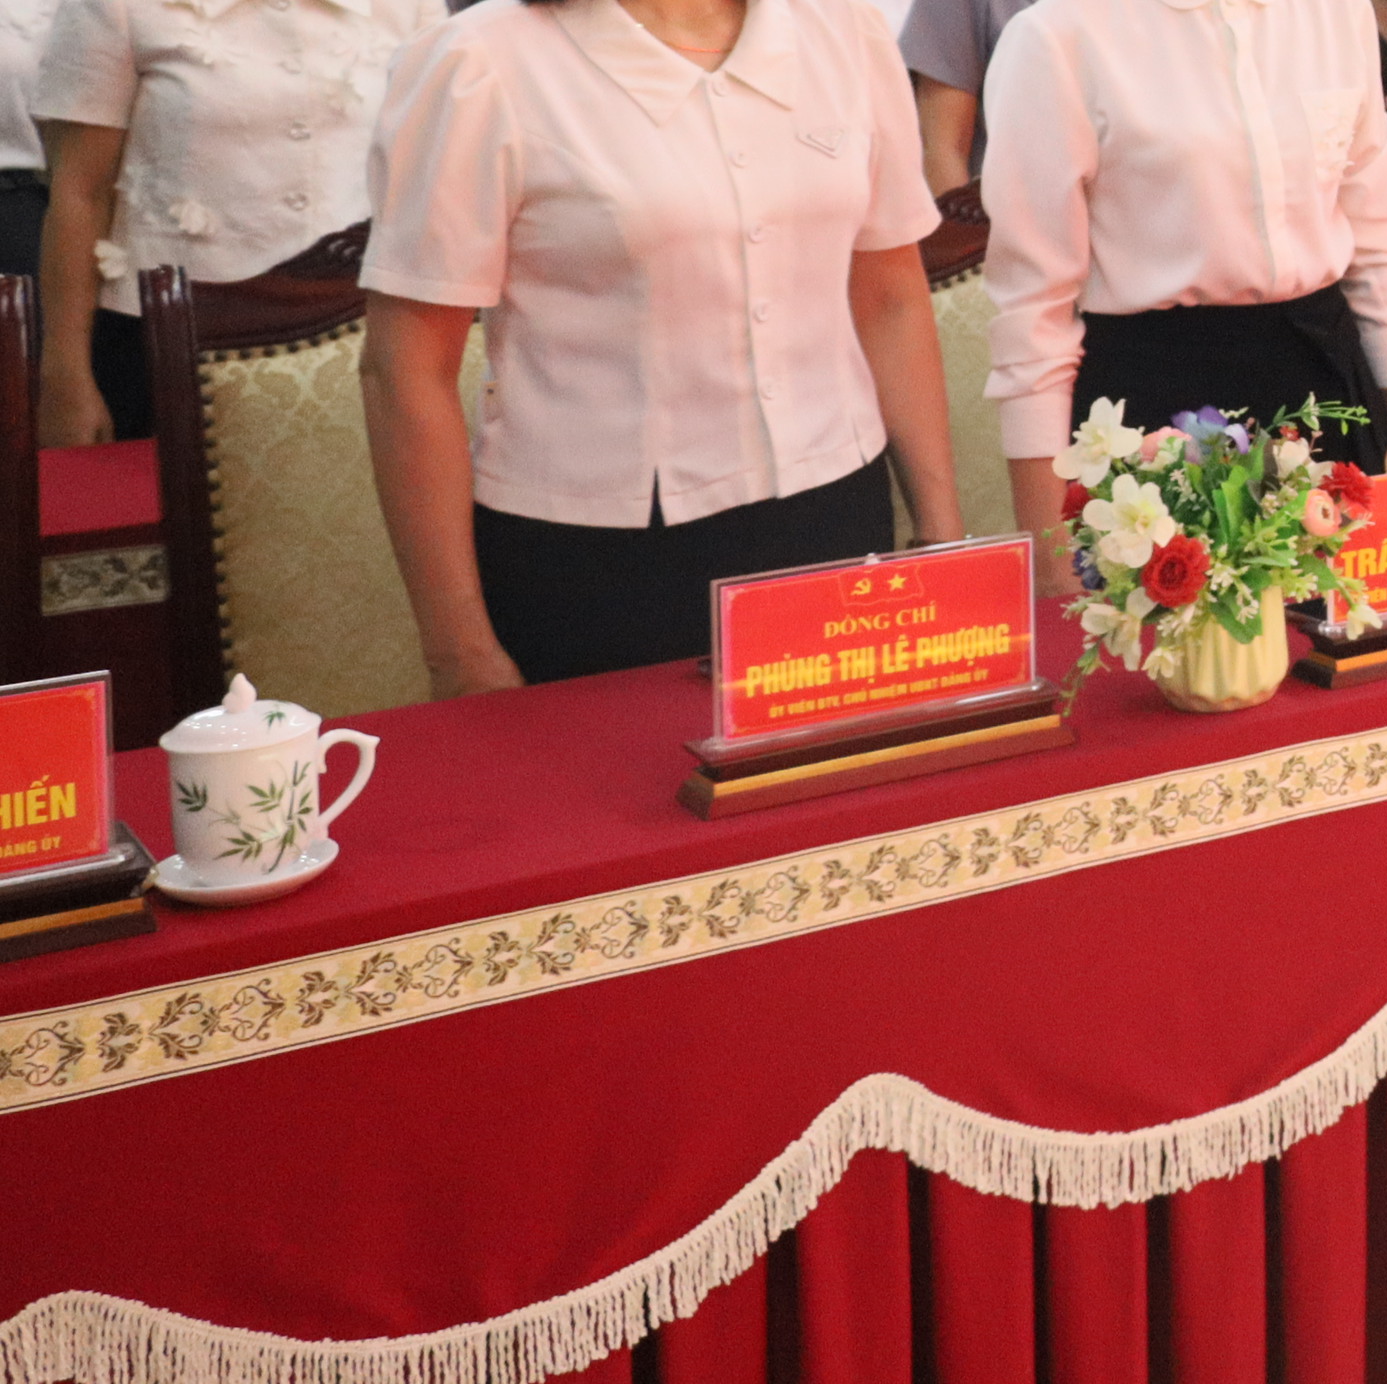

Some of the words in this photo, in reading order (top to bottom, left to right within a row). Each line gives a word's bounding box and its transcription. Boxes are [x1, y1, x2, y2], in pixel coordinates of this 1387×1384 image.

[824, 612, 890, 639] ĐỒNG
[895, 600, 937, 625] CHÍ
[838, 645, 876, 684] THỊ
[916, 623, 1011, 668] PHƯỢNG
